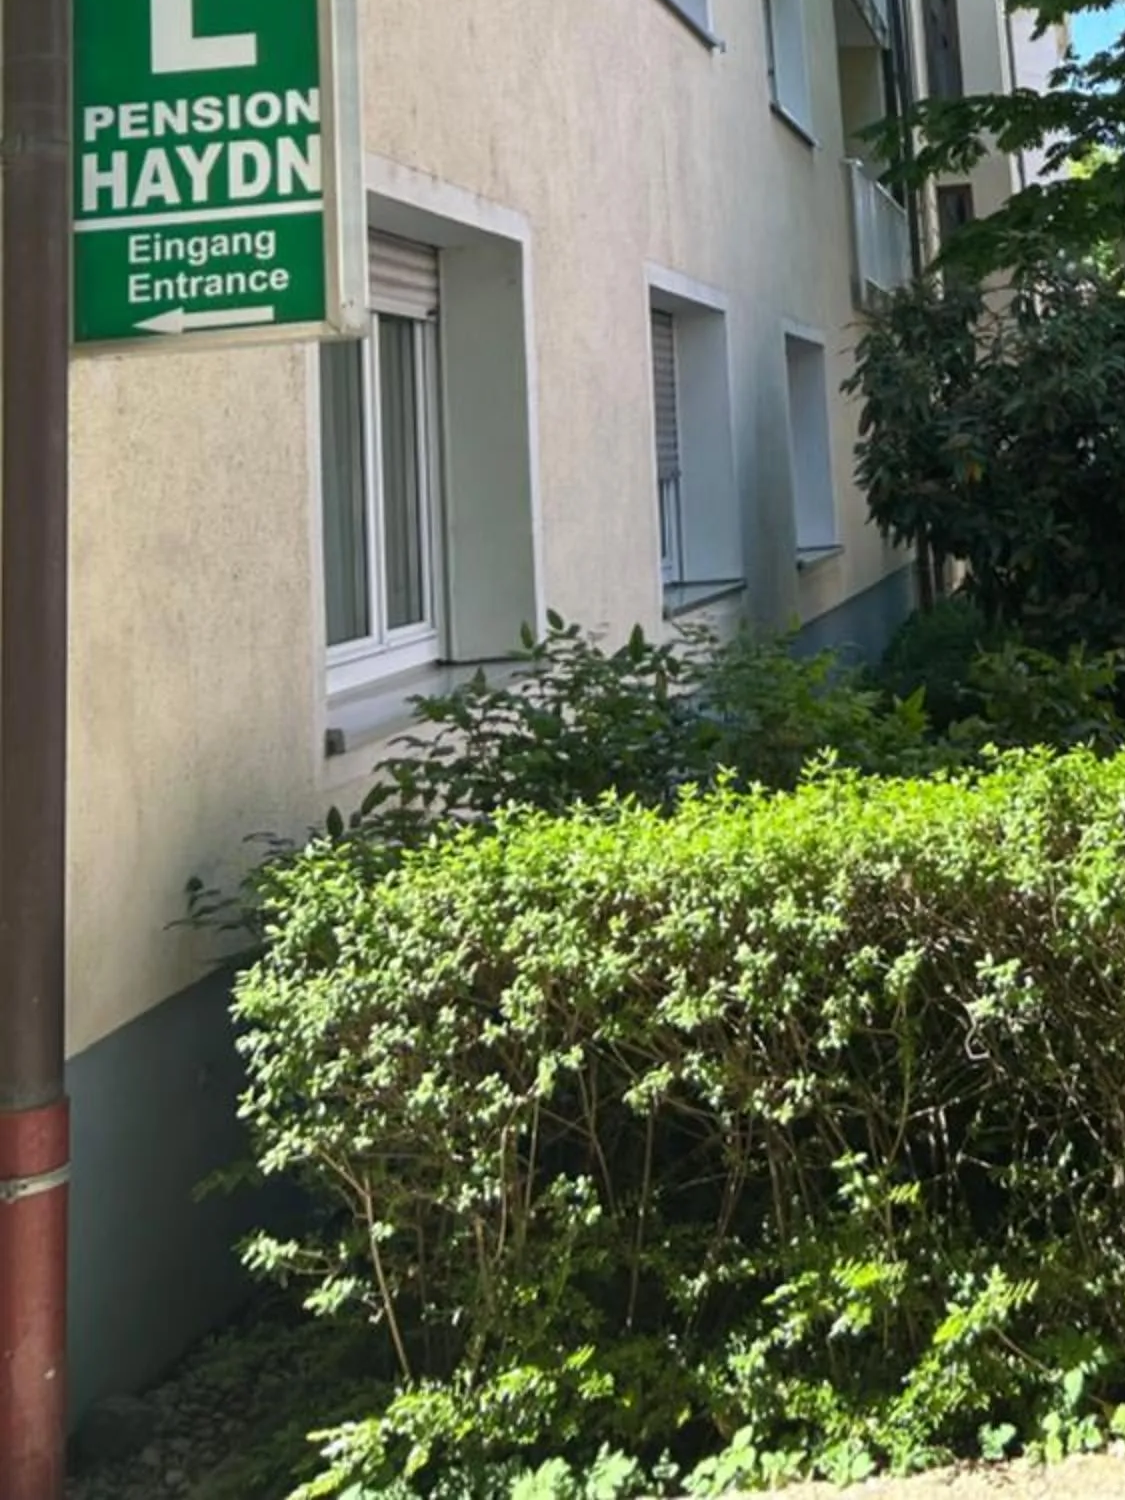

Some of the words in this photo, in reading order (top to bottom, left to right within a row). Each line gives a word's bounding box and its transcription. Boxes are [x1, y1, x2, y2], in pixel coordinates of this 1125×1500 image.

[83, 88, 320, 142] PENSION
[82, 134, 322, 212] HAYDN
[128, 230, 276, 266] Eingang
[128, 268, 290, 303] Entrance
